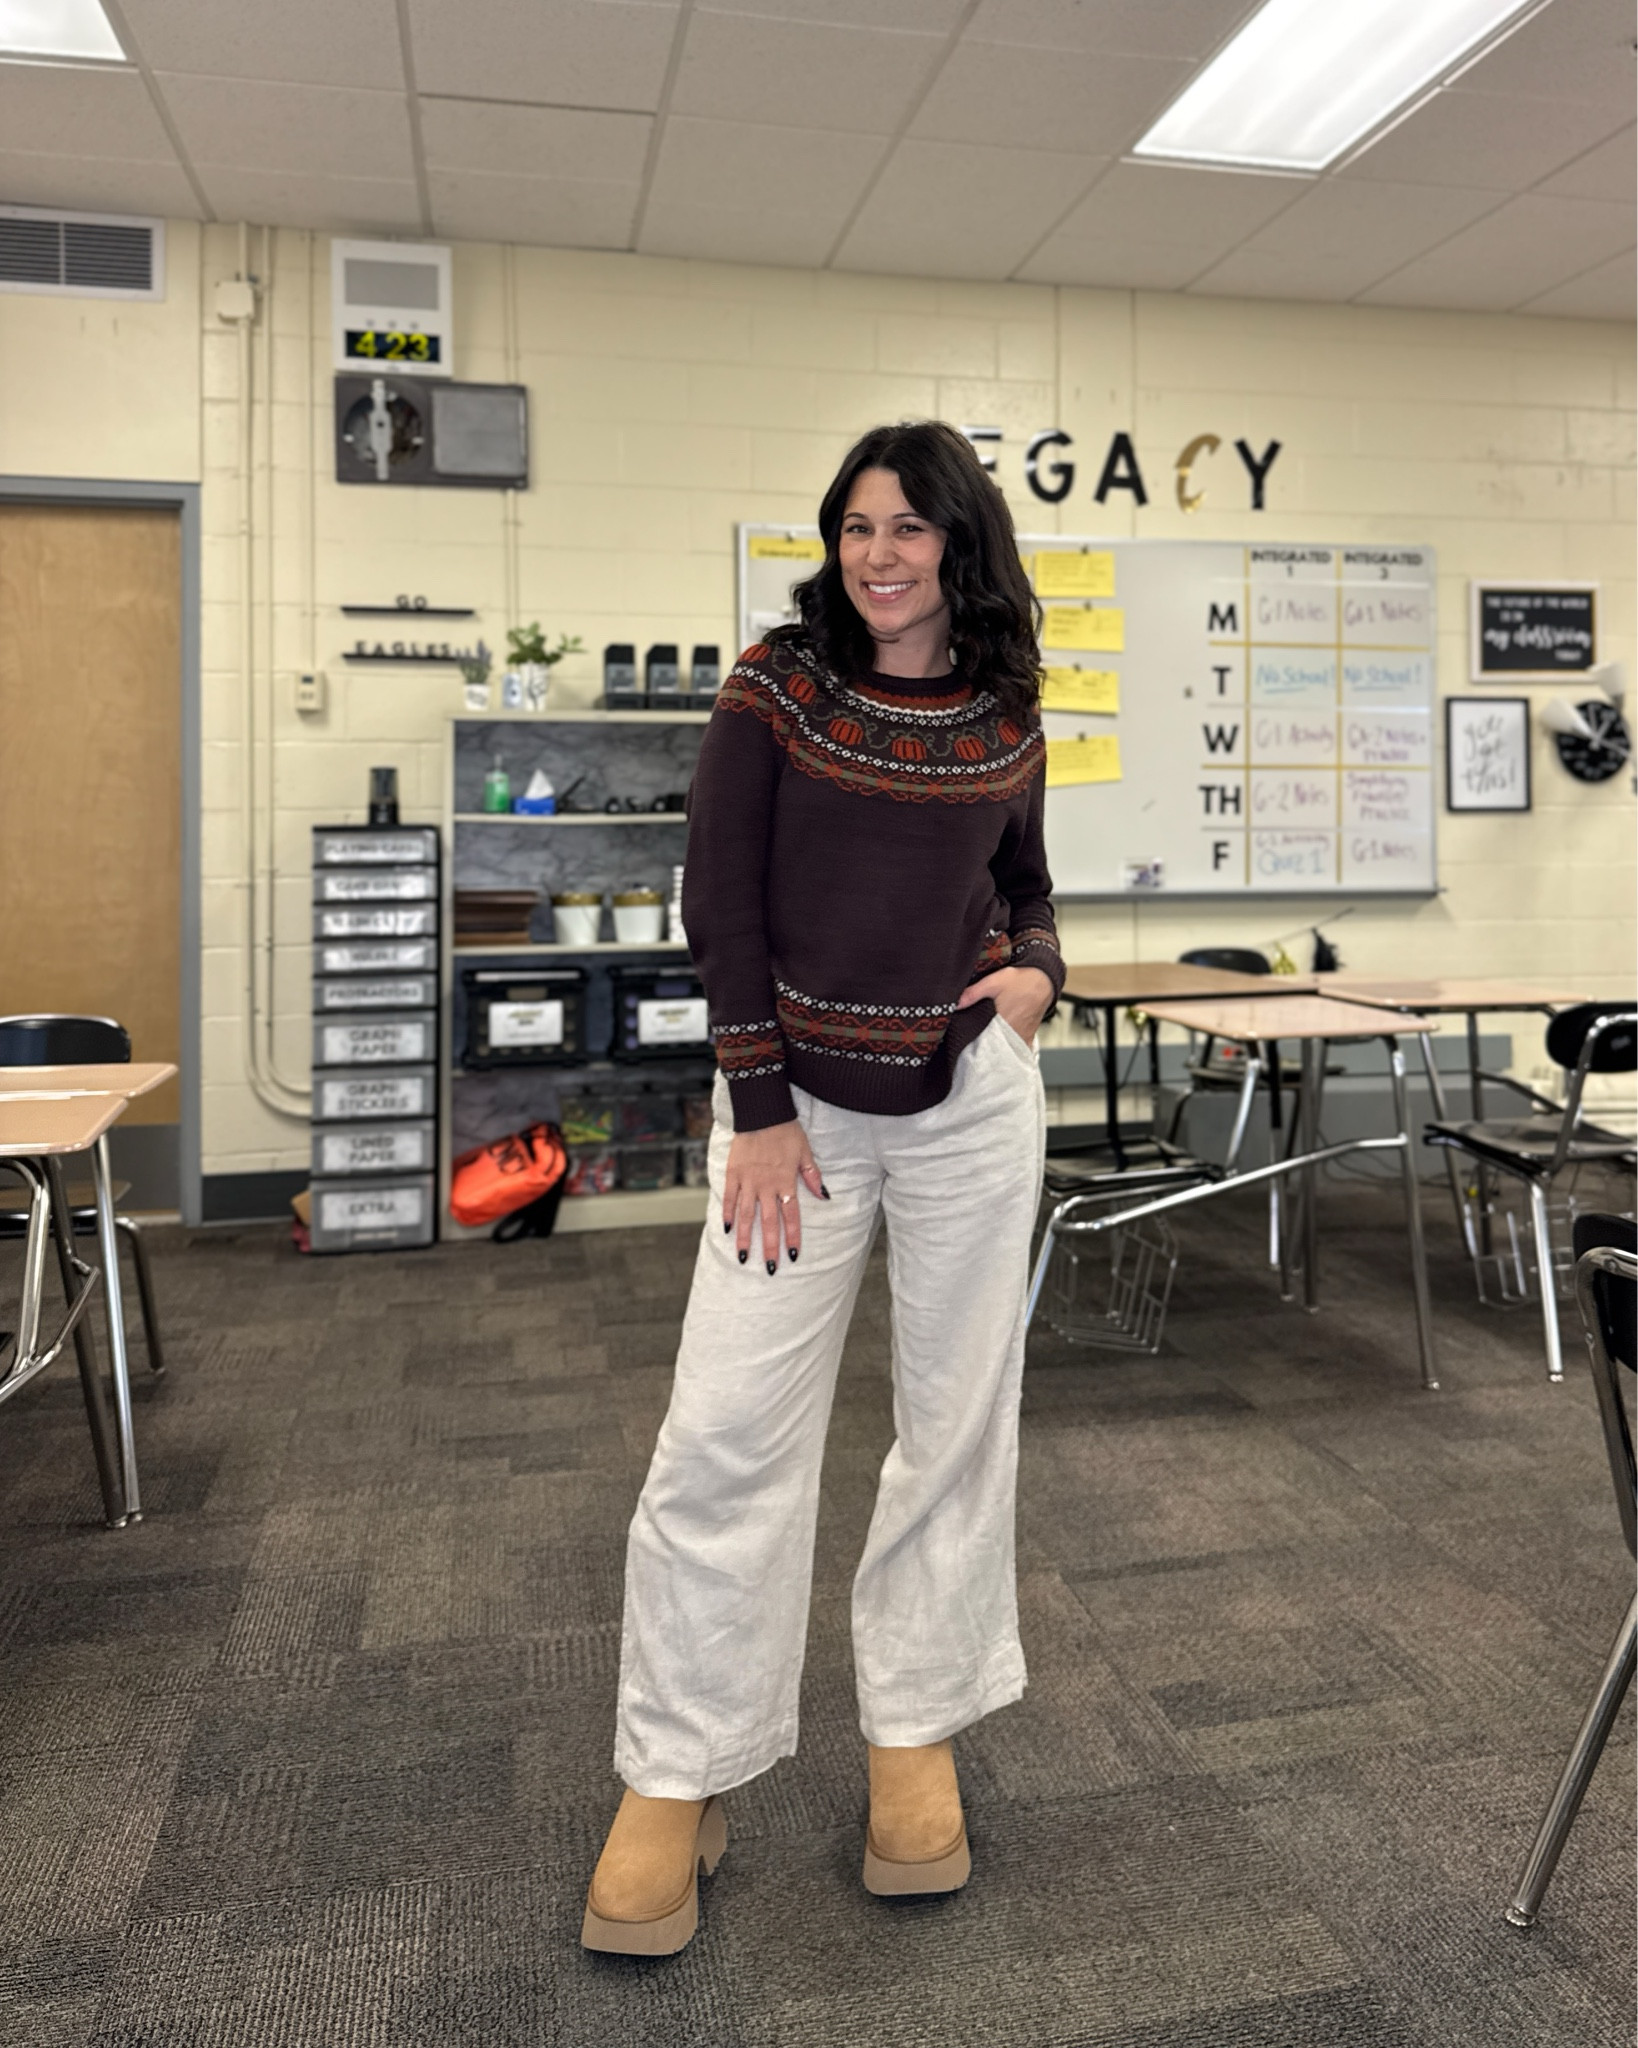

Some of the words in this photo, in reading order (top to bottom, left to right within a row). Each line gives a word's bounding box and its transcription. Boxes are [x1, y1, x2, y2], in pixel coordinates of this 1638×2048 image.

[1251, 551, 1332, 564] INTEGRATED
[1344, 553, 1423, 566] INTEGRATED
[396, 595, 427, 610] GO
[1208, 602, 1238, 632] M
[356, 641, 450, 657] EAGLES
[1212, 666, 1231, 695] T
[1203, 724, 1239, 753] W
[1198, 785, 1241, 815] TH
[1213, 841, 1230, 870] F
[349, 1029, 401, 1041] GRAPH
[351, 1043, 397, 1055] PAPER
[347, 1084, 399, 1096] GRAPH
[337, 1097, 409, 1111] STICKERS
[350, 1137, 395, 1149] LINED
[349, 1151, 396, 1163] PAPER
[348, 1201, 397, 1215] EXTRA
